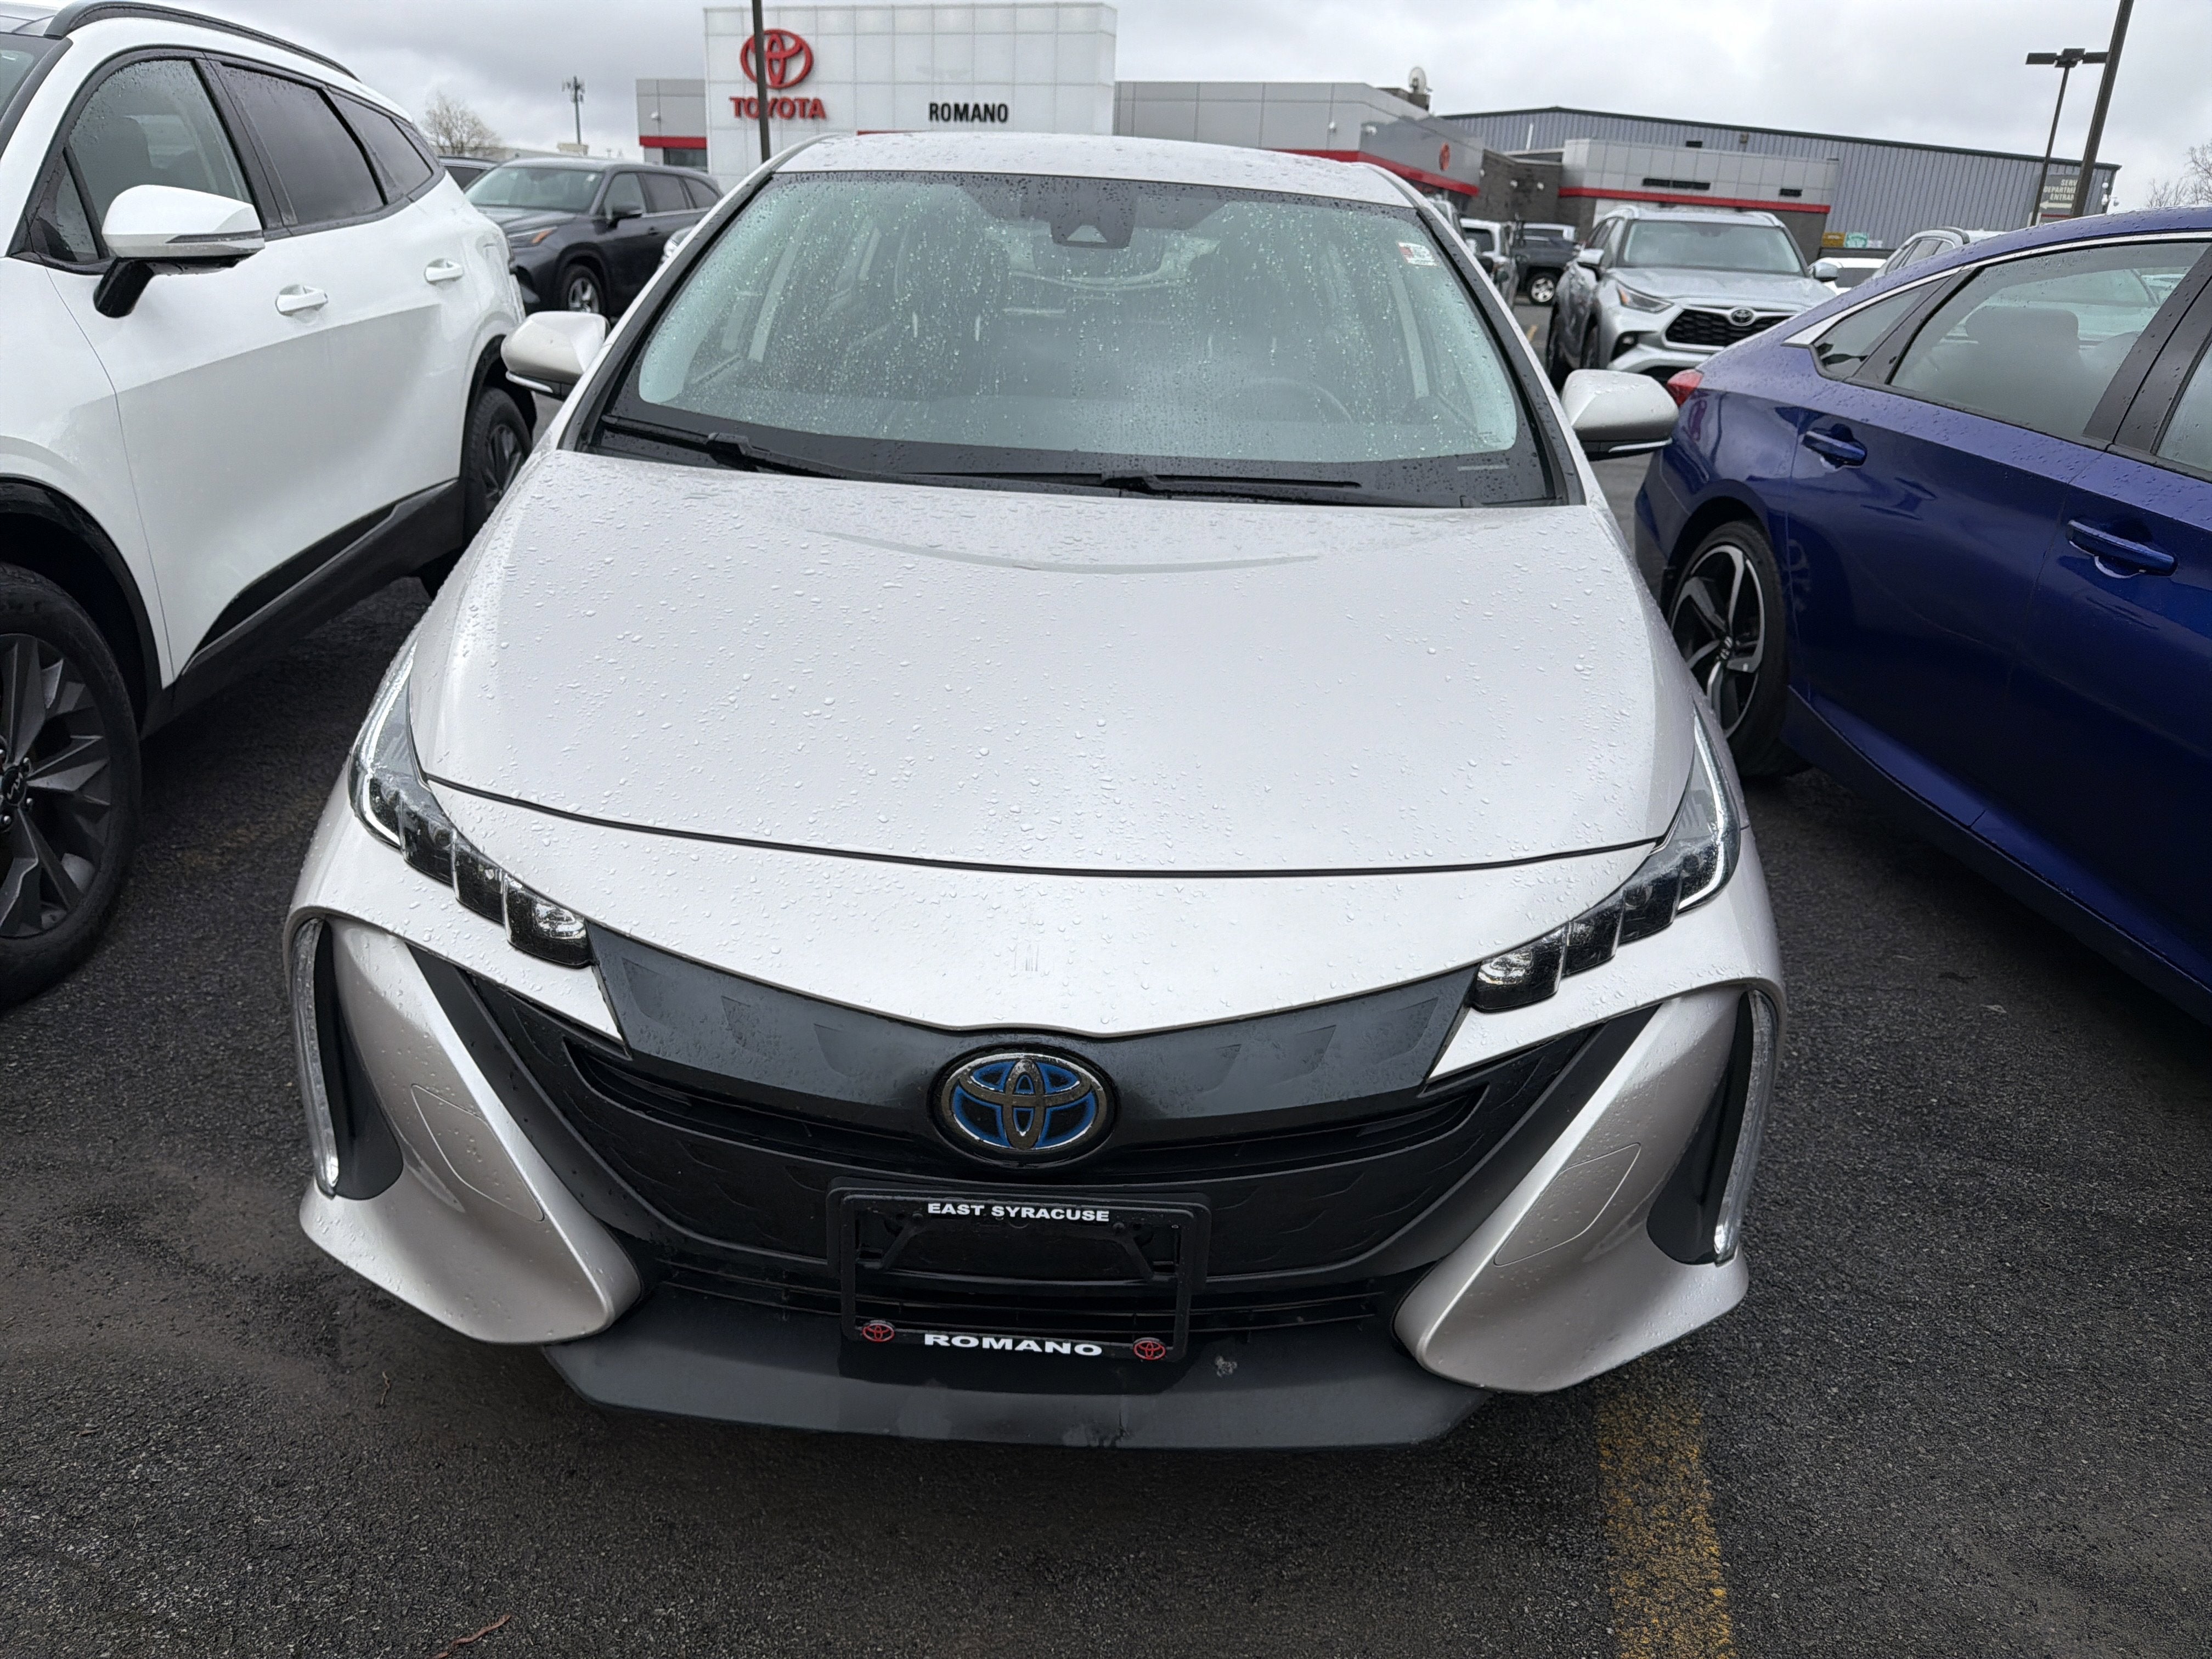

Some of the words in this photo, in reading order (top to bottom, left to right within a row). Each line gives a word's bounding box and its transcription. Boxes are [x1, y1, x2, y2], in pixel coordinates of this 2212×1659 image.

[729, 96, 826, 119] TOYOTA
[929, 103, 1008, 123] ROMANO
[2049, 193, 2074, 201] ENTRAN
[928, 1203, 985, 1216] EAST
[991, 1205, 1110, 1222] SYRACUSE
[924, 1334, 1103, 1356] ROMANO
